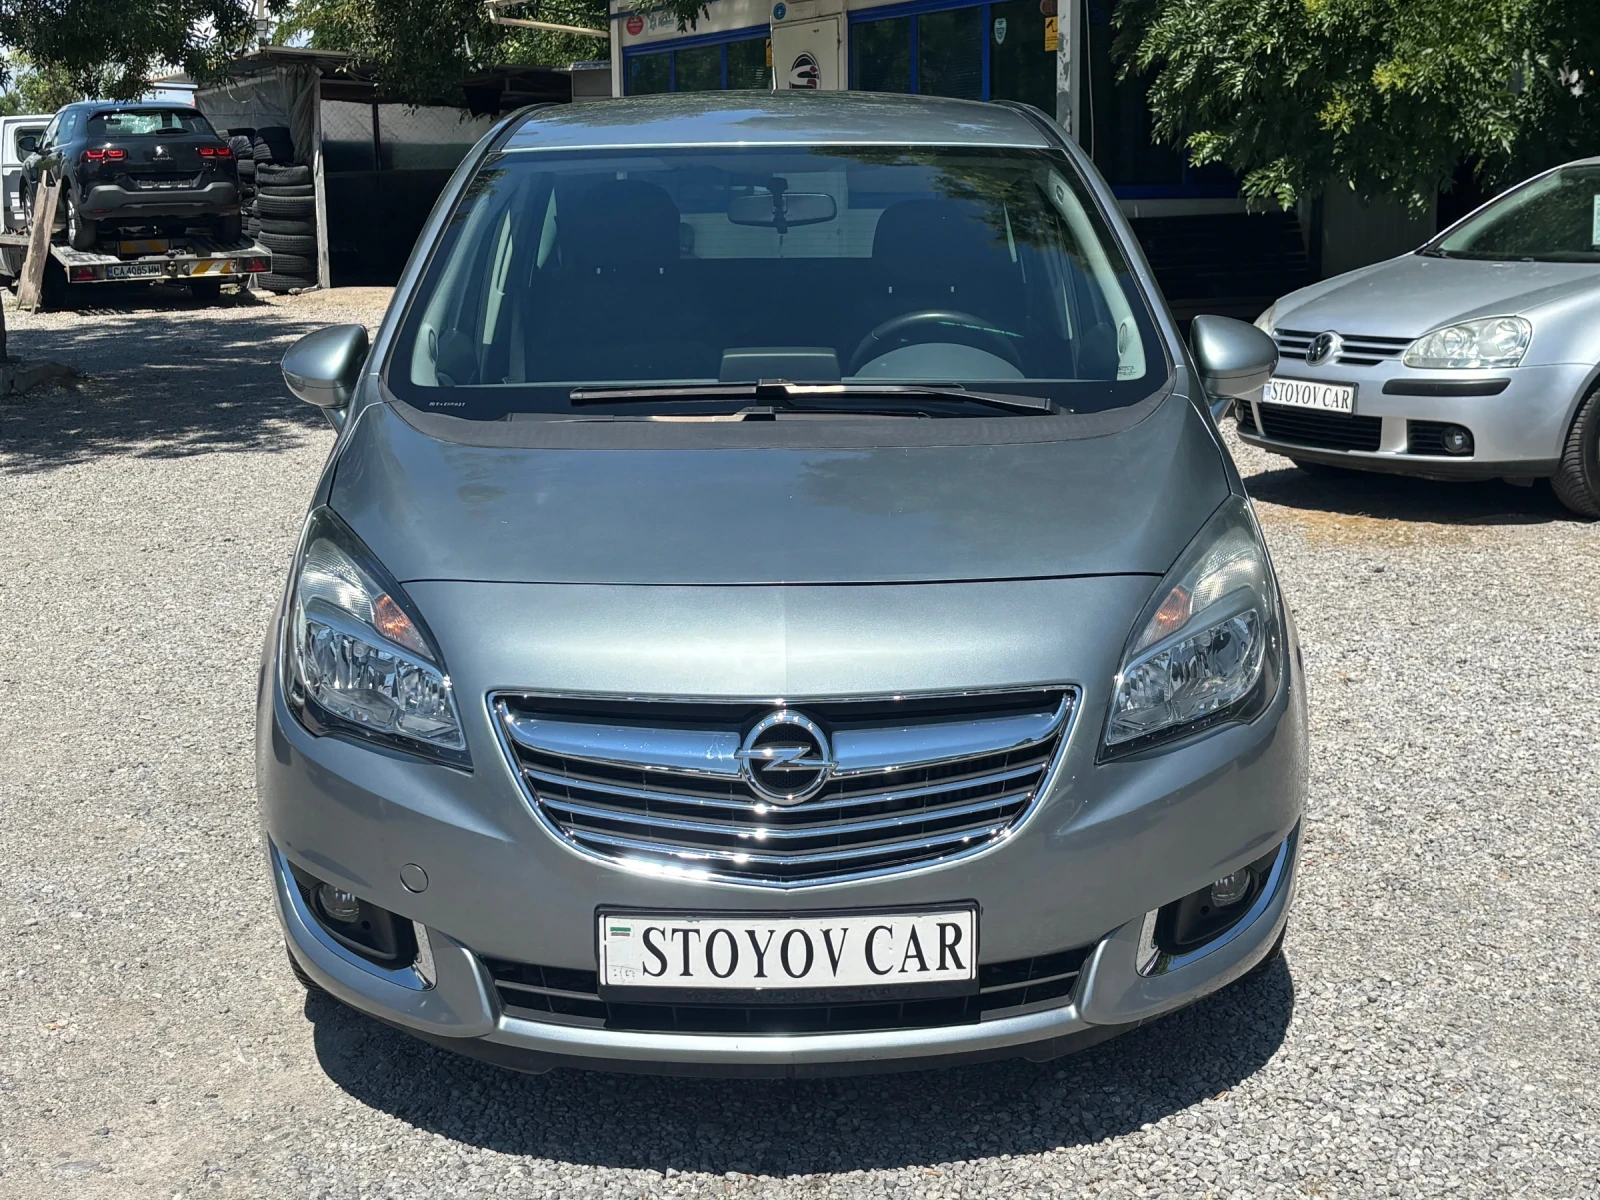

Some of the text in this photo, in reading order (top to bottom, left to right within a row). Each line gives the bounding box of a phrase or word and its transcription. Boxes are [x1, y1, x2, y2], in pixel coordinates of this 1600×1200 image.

[1271, 381, 1350, 409] STOYOV CAR
[642, 922, 967, 978] STOYOV CAR
